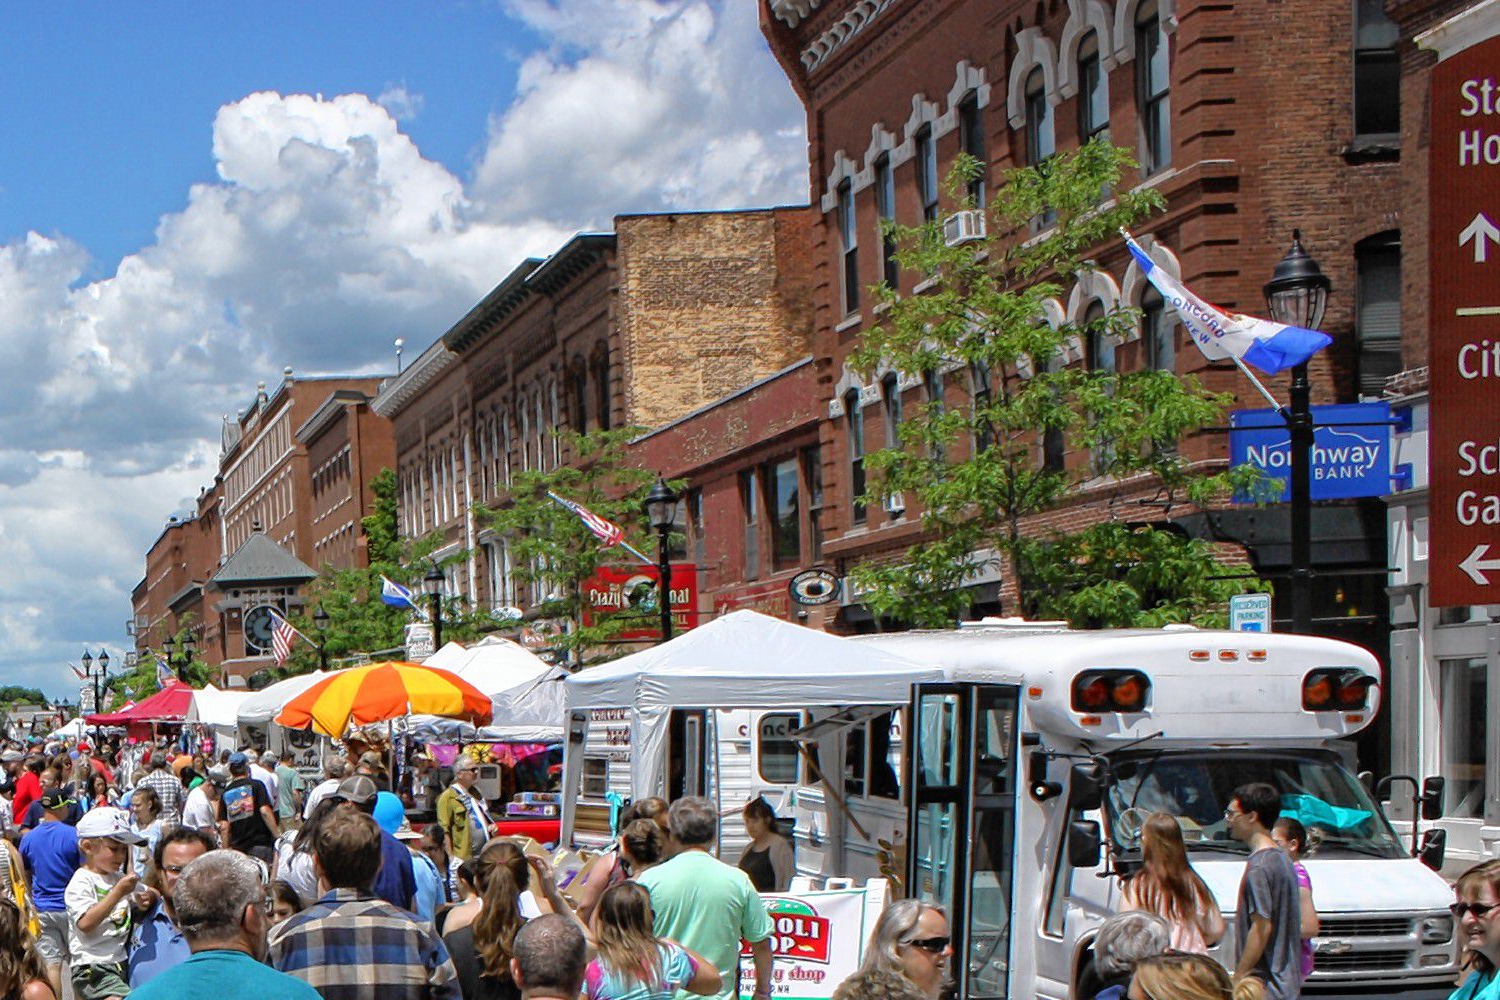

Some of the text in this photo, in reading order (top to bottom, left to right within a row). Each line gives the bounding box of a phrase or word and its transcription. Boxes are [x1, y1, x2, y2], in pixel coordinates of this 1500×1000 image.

[1247, 443, 1380, 469] Norhway
[1458, 441, 1500, 477] Sc
[1314, 465, 1366, 481] BANK
[590, 589, 621, 609] Crazy
[788, 966, 826, 984] shop
